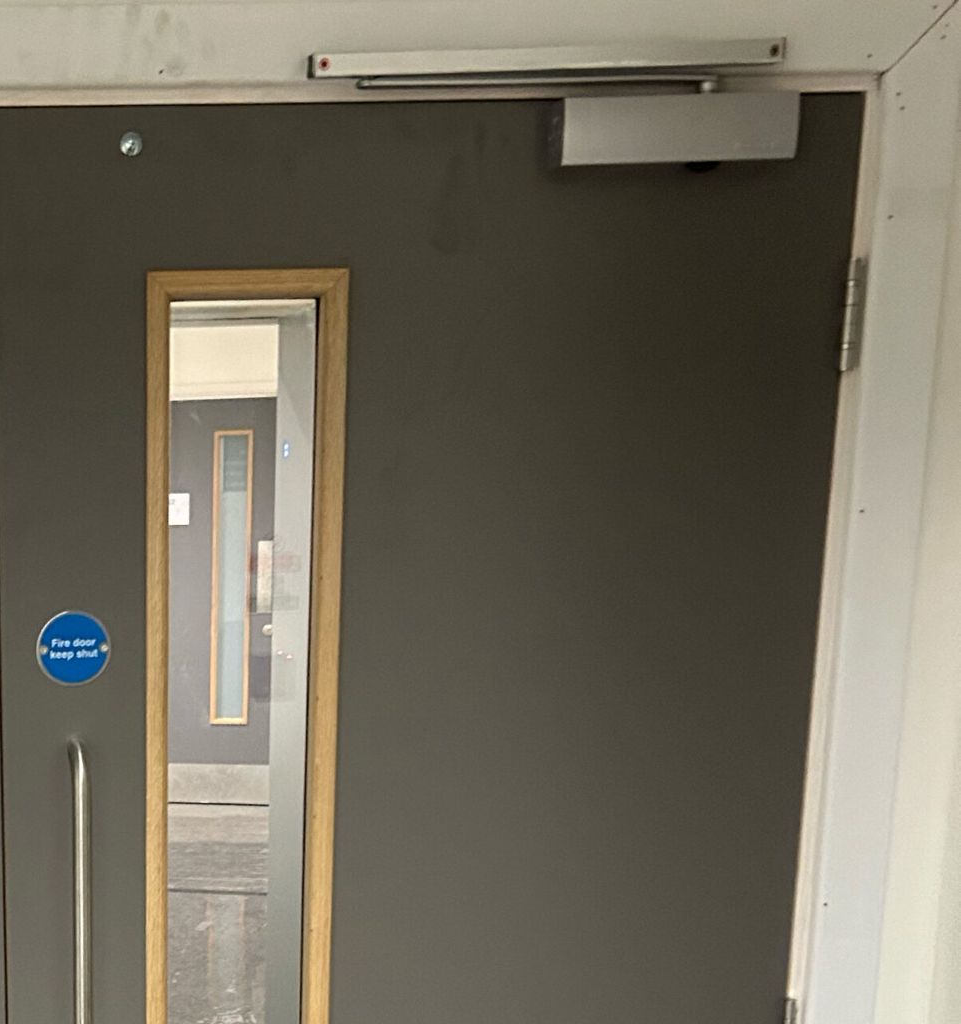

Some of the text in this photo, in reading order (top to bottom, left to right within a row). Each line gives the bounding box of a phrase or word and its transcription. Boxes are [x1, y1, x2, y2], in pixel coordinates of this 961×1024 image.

[51, 638, 96, 648] Fire door
[50, 649, 98, 661] keep shut
